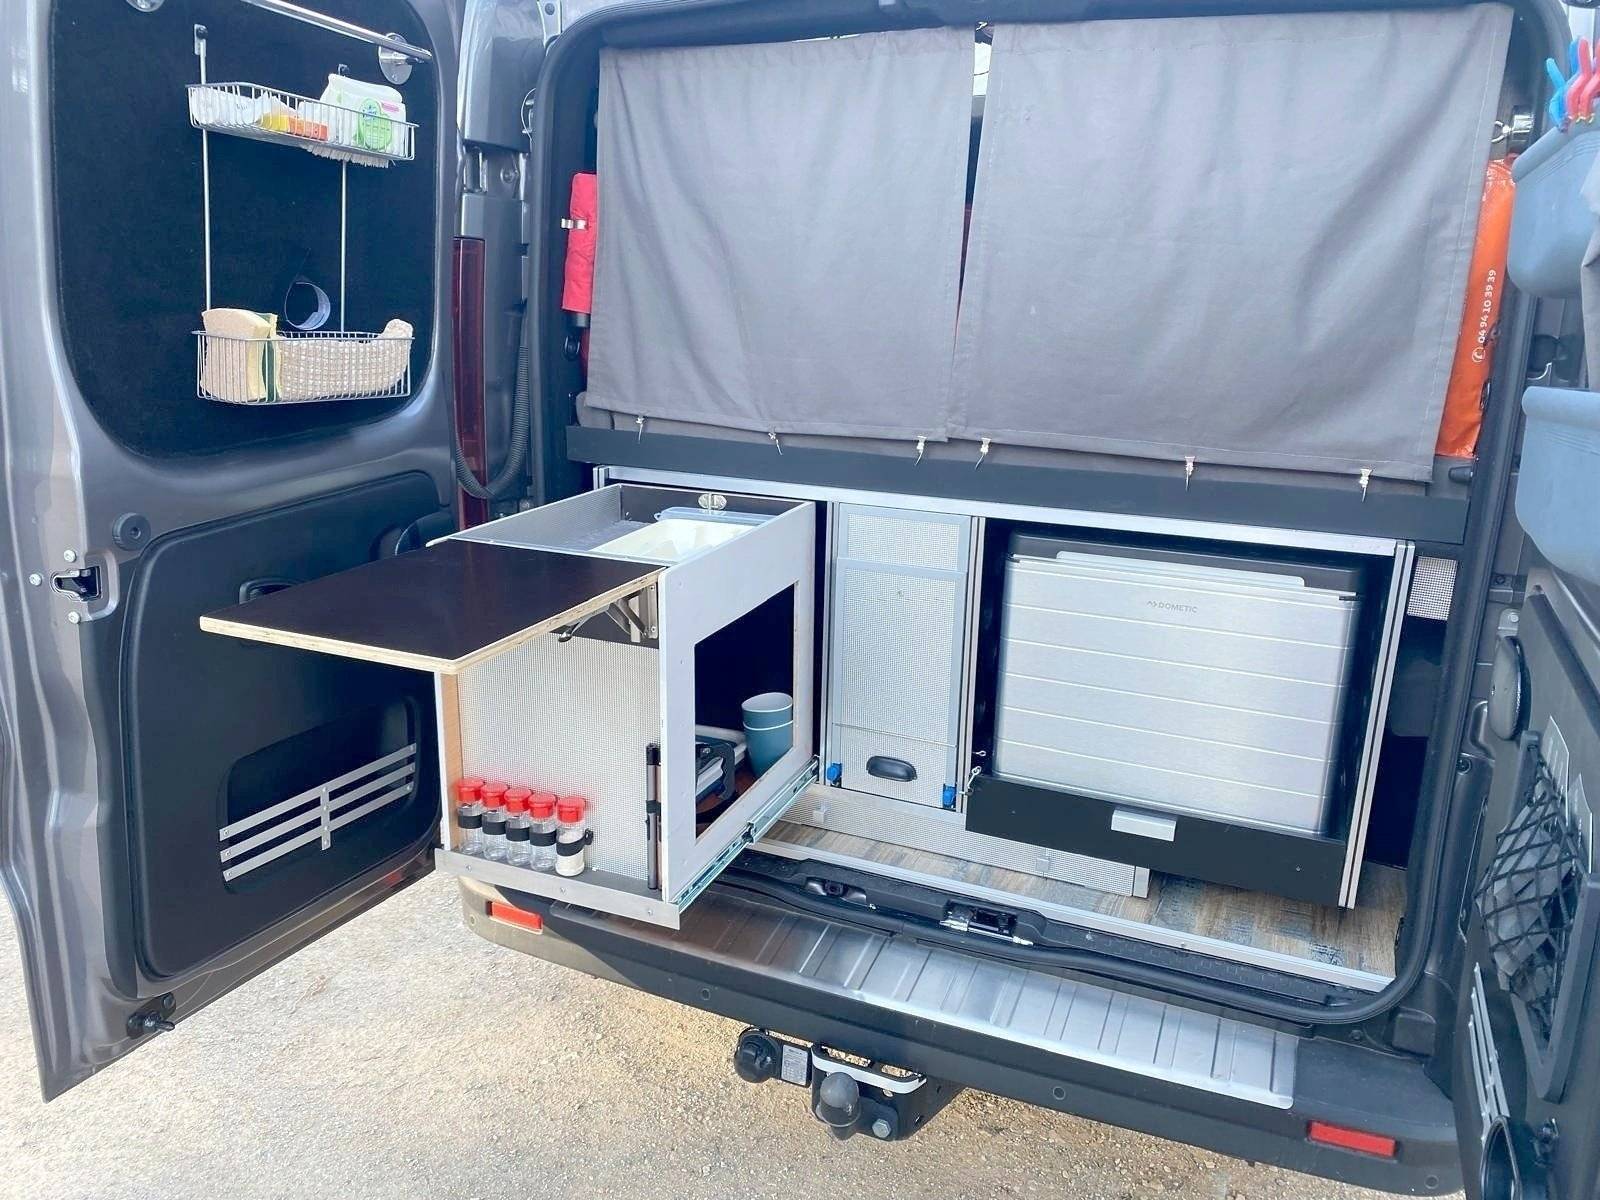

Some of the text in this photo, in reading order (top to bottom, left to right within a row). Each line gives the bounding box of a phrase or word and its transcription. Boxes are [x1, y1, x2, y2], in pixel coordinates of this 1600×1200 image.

[1478, 269, 1497, 344] 04 94 10 39 39
[1158, 601, 1199, 613] DOMETIC
